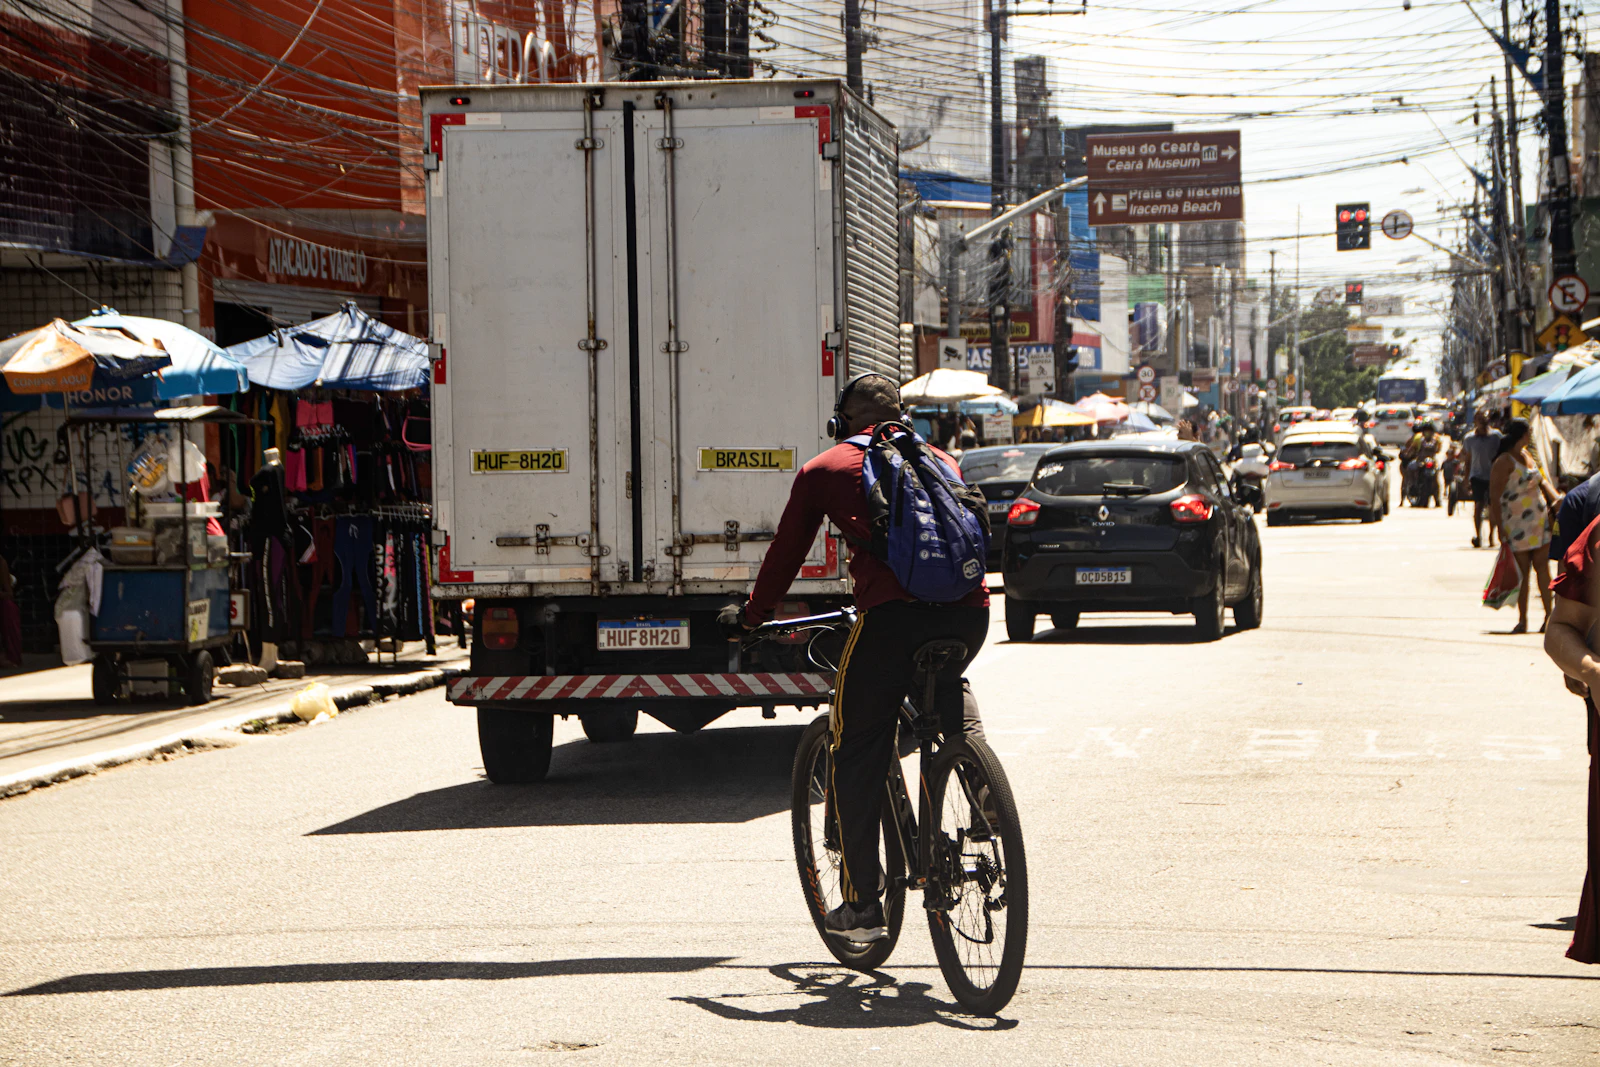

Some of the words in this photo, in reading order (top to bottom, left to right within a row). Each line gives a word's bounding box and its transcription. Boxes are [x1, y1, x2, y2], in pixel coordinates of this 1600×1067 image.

[1093, 145, 1135, 157] Museu
[1140, 143, 1156, 154] do
[1161, 141, 1200, 153] Ceará
[1106, 159, 1143, 172] Ceará
[1147, 157, 1200, 170] Museum
[1129, 187, 1162, 200] Praia
[1167, 186, 1183, 198] de
[1188, 184, 1240, 198] Iracema
[1129, 203, 1179, 216] Iracema
[1182, 200, 1221, 213] Beach
[269, 237, 318, 278] ATACADO
[320, 246, 328, 280] E
[329, 246, 367, 285] VAREJO
[13, 377, 57, 388] COMPRE
[61, 374, 87, 386] AQUI
[1141, 370, 1153, 378] 30
[68, 386, 133, 404] HONOR
[477, 452, 562, 470] HUF-8H20
[716, 451, 779, 468] BRASIL
[607, 628, 680, 647] HUF8H20
